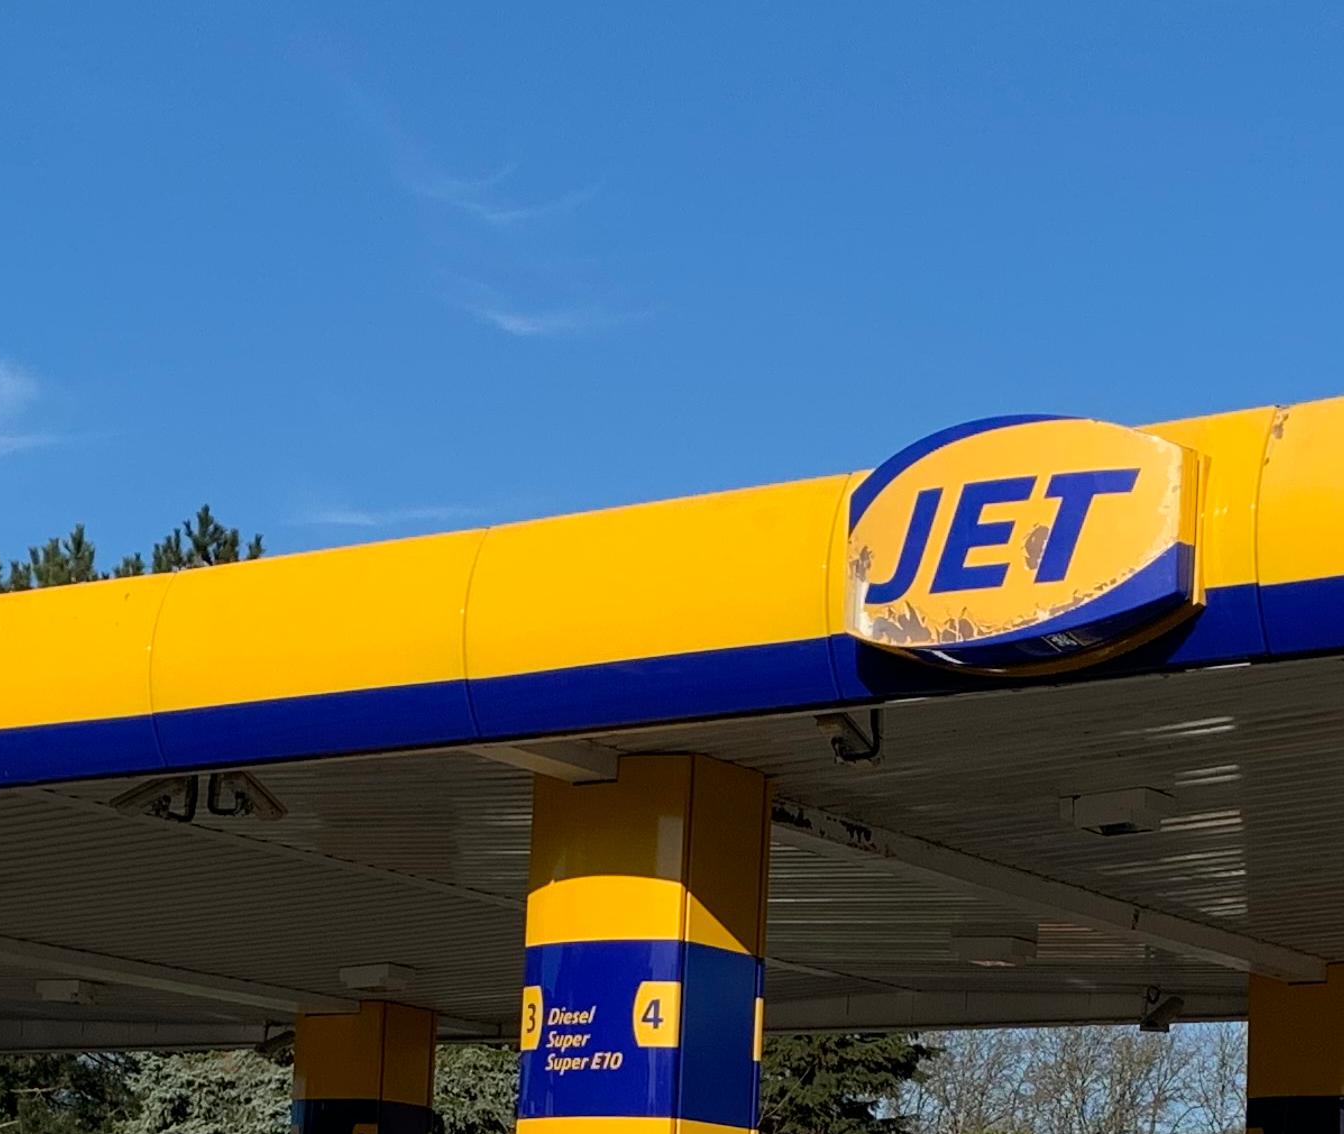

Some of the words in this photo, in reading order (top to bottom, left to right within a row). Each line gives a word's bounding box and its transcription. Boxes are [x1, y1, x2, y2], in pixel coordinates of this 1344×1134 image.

[865, 468, 1140, 605] JET
[526, 1002, 537, 1034] 3
[547, 1005, 597, 1026] Diesel
[641, 999, 663, 1030] 4
[545, 1031, 591, 1053] Super
[544, 1053, 589, 1076] Super
[590, 1051, 624, 1070] E10
